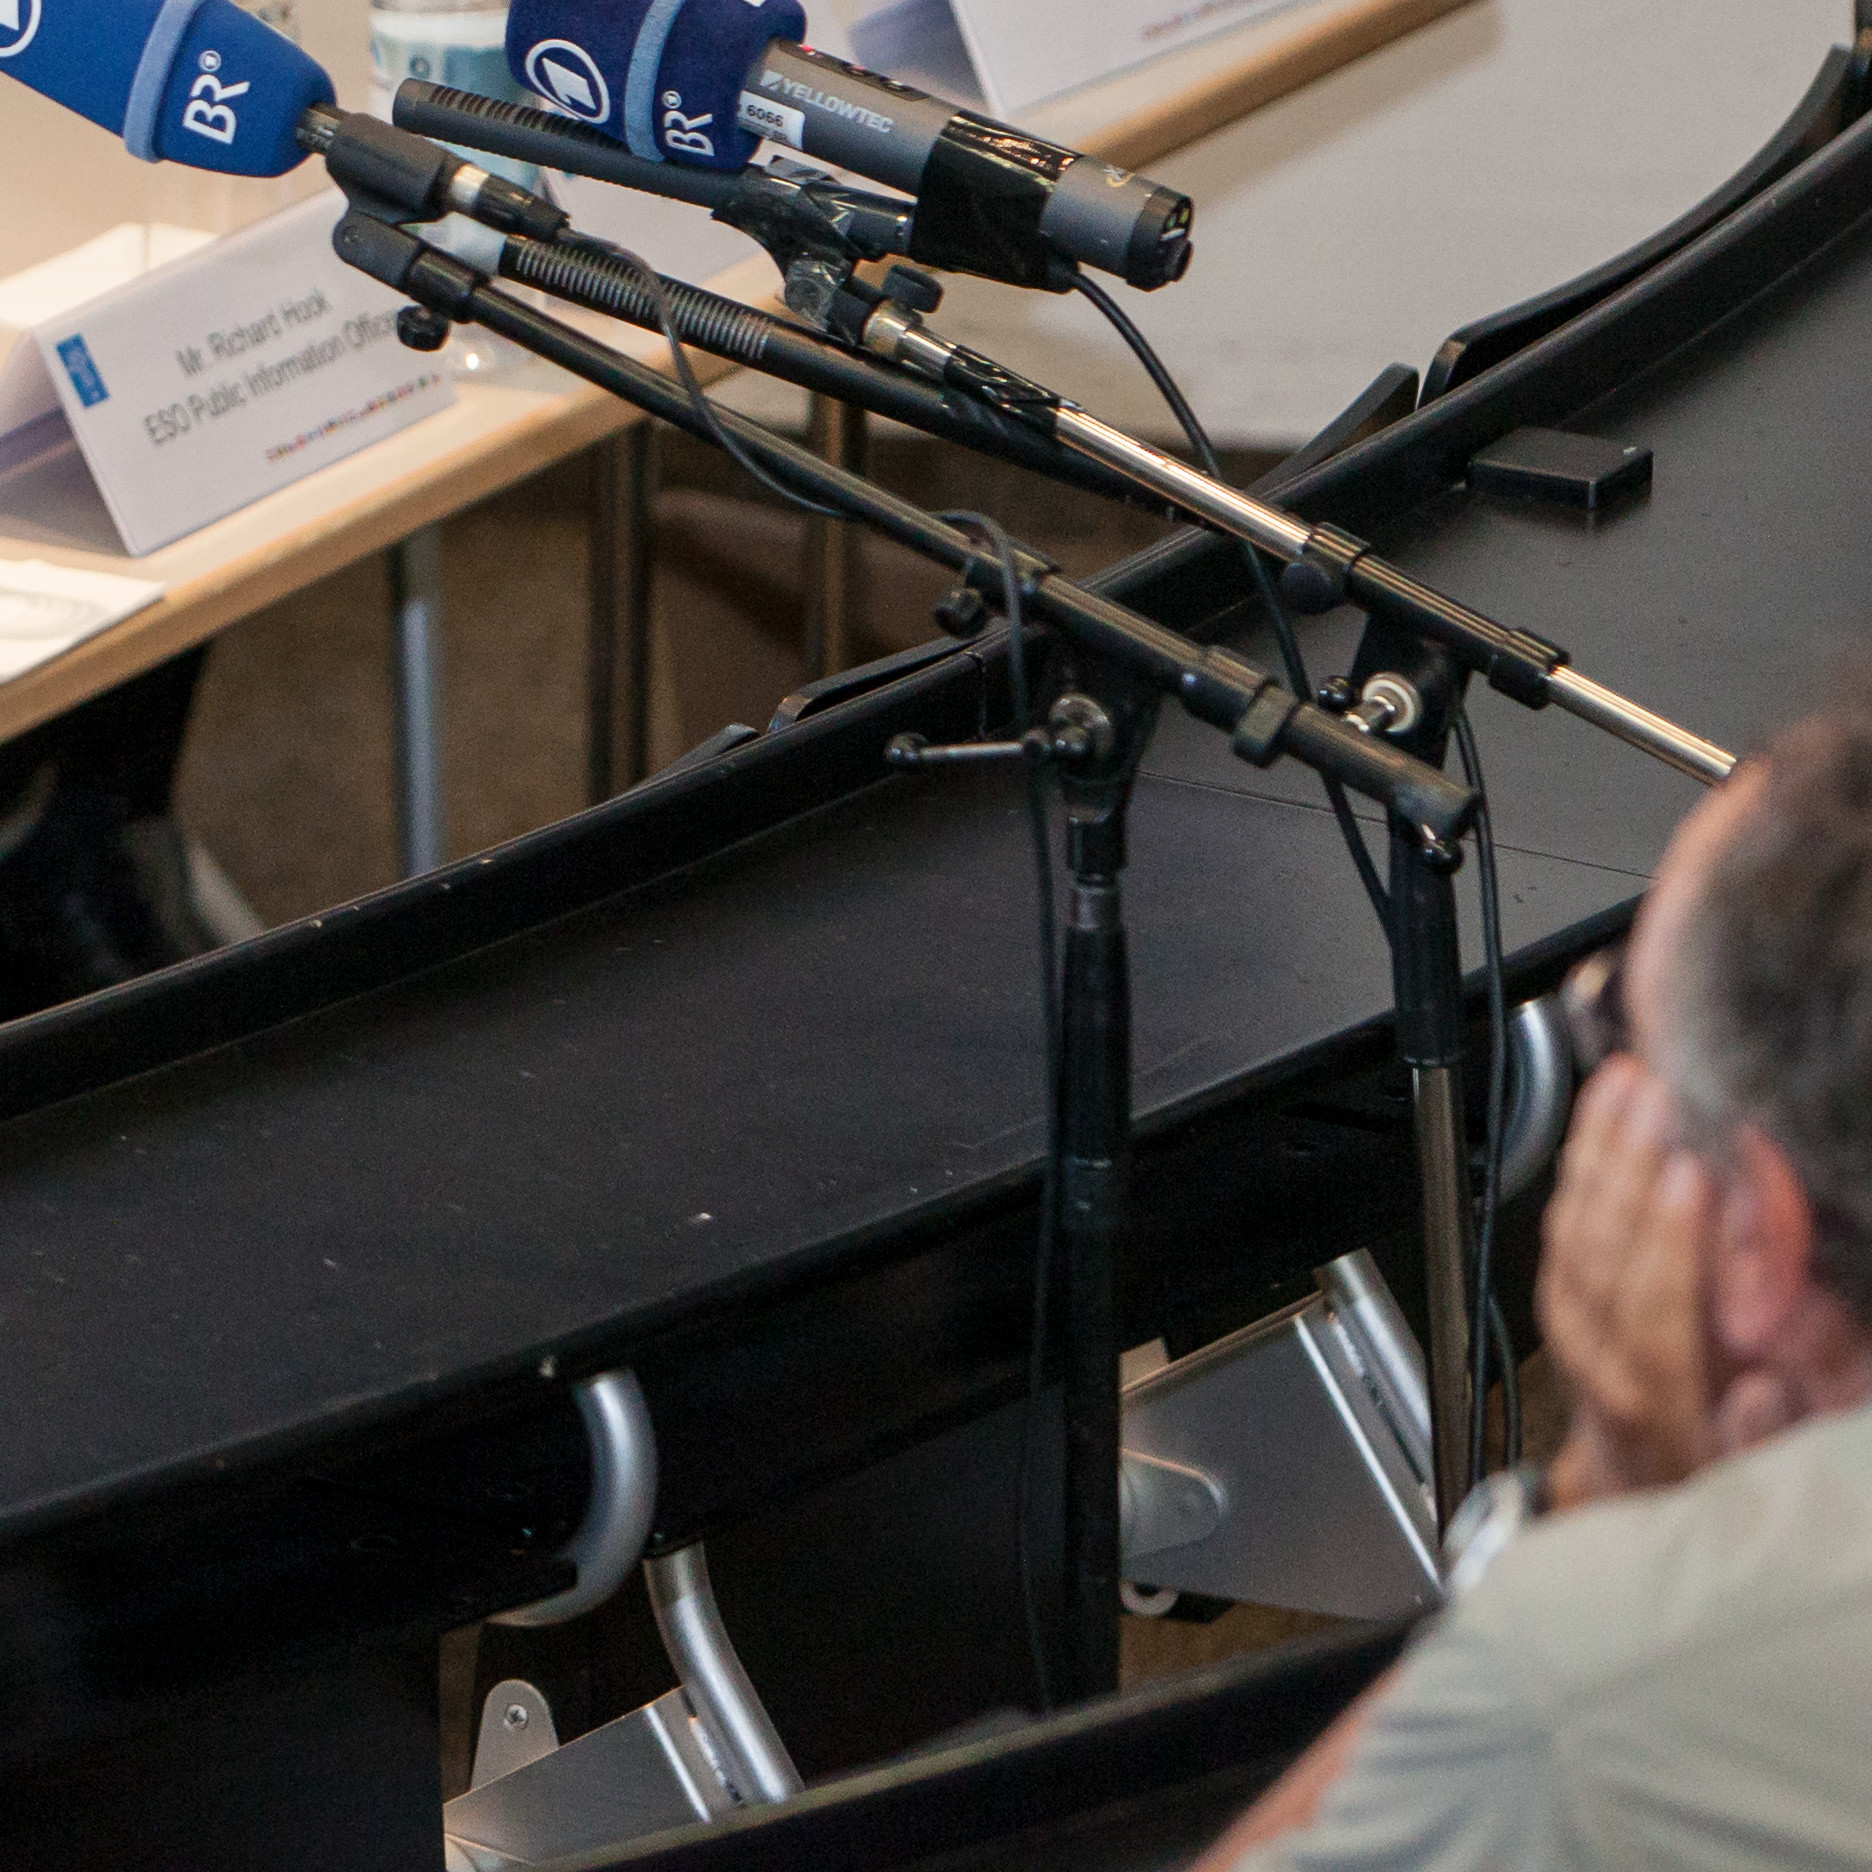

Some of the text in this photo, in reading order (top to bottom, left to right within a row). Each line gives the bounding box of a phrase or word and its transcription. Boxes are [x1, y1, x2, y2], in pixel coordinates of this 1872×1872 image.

[182, 73, 251, 145] BR
[663, 109, 716, 157] BR
[782, 78, 895, 134] YELLOWTEC
